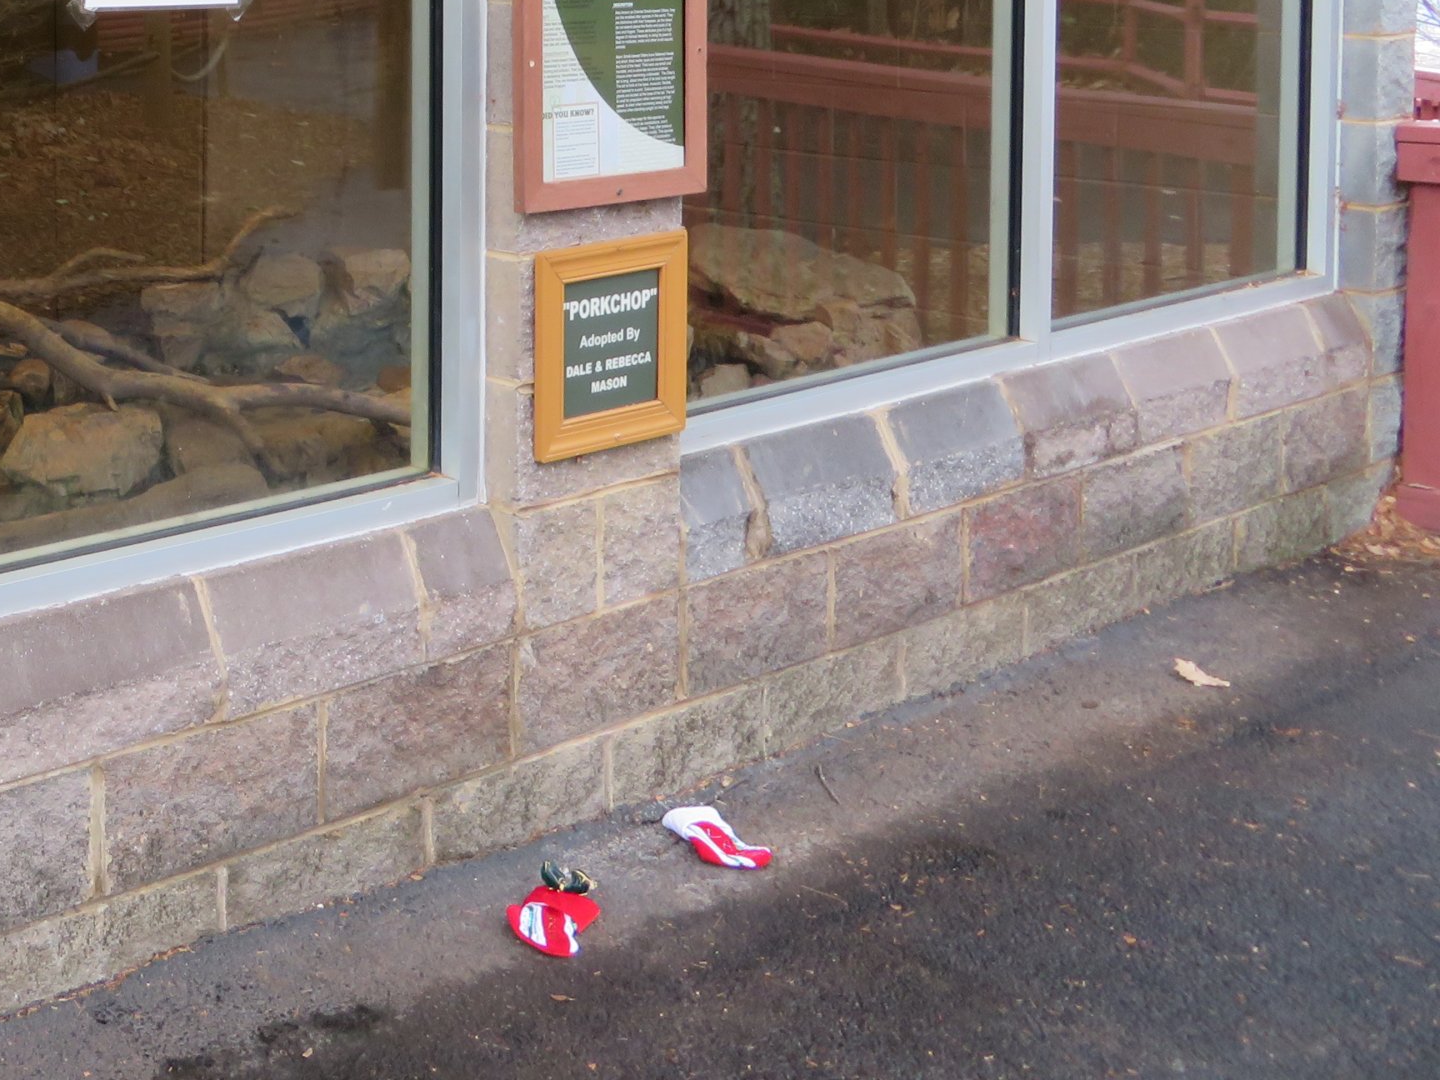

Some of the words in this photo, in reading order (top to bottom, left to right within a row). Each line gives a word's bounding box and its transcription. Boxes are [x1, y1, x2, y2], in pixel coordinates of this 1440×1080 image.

[554, 110, 569, 119] YOU
[569, 107, 594, 118] KNOW?
[563, 287, 658, 321] "PORKCHOP"
[579, 328, 624, 349] Adopted
[626, 327, 641, 342] By
[566, 362, 592, 378] DALE
[594, 360, 603, 373] &
[605, 351, 652, 371] REBECCA
[591, 375, 628, 394] MASON
